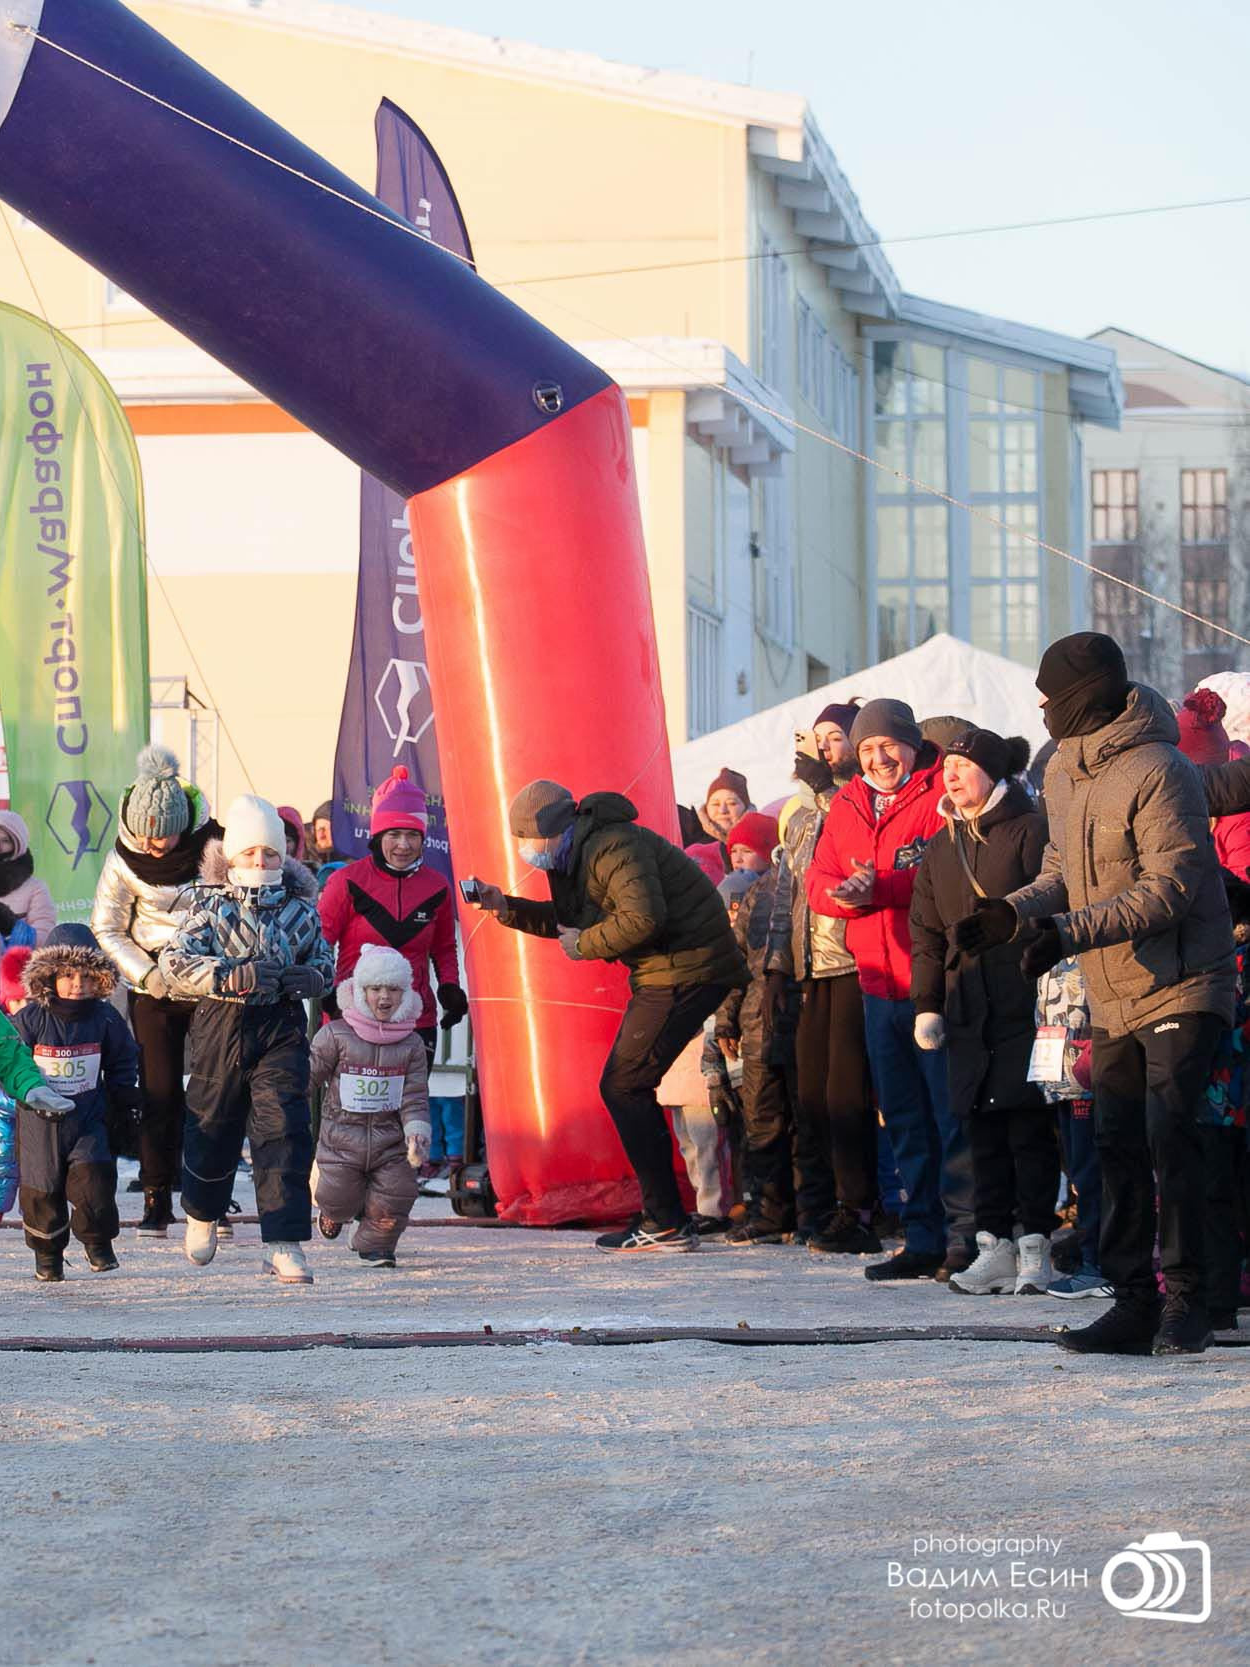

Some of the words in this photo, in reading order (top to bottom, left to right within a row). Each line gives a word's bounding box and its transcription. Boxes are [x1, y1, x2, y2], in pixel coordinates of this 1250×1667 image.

[55, 1049, 72, 1057] 300
[49, 1060, 86, 1078] 305
[361, 1067, 378, 1076] 300
[354, 1079, 390, 1097] 302
